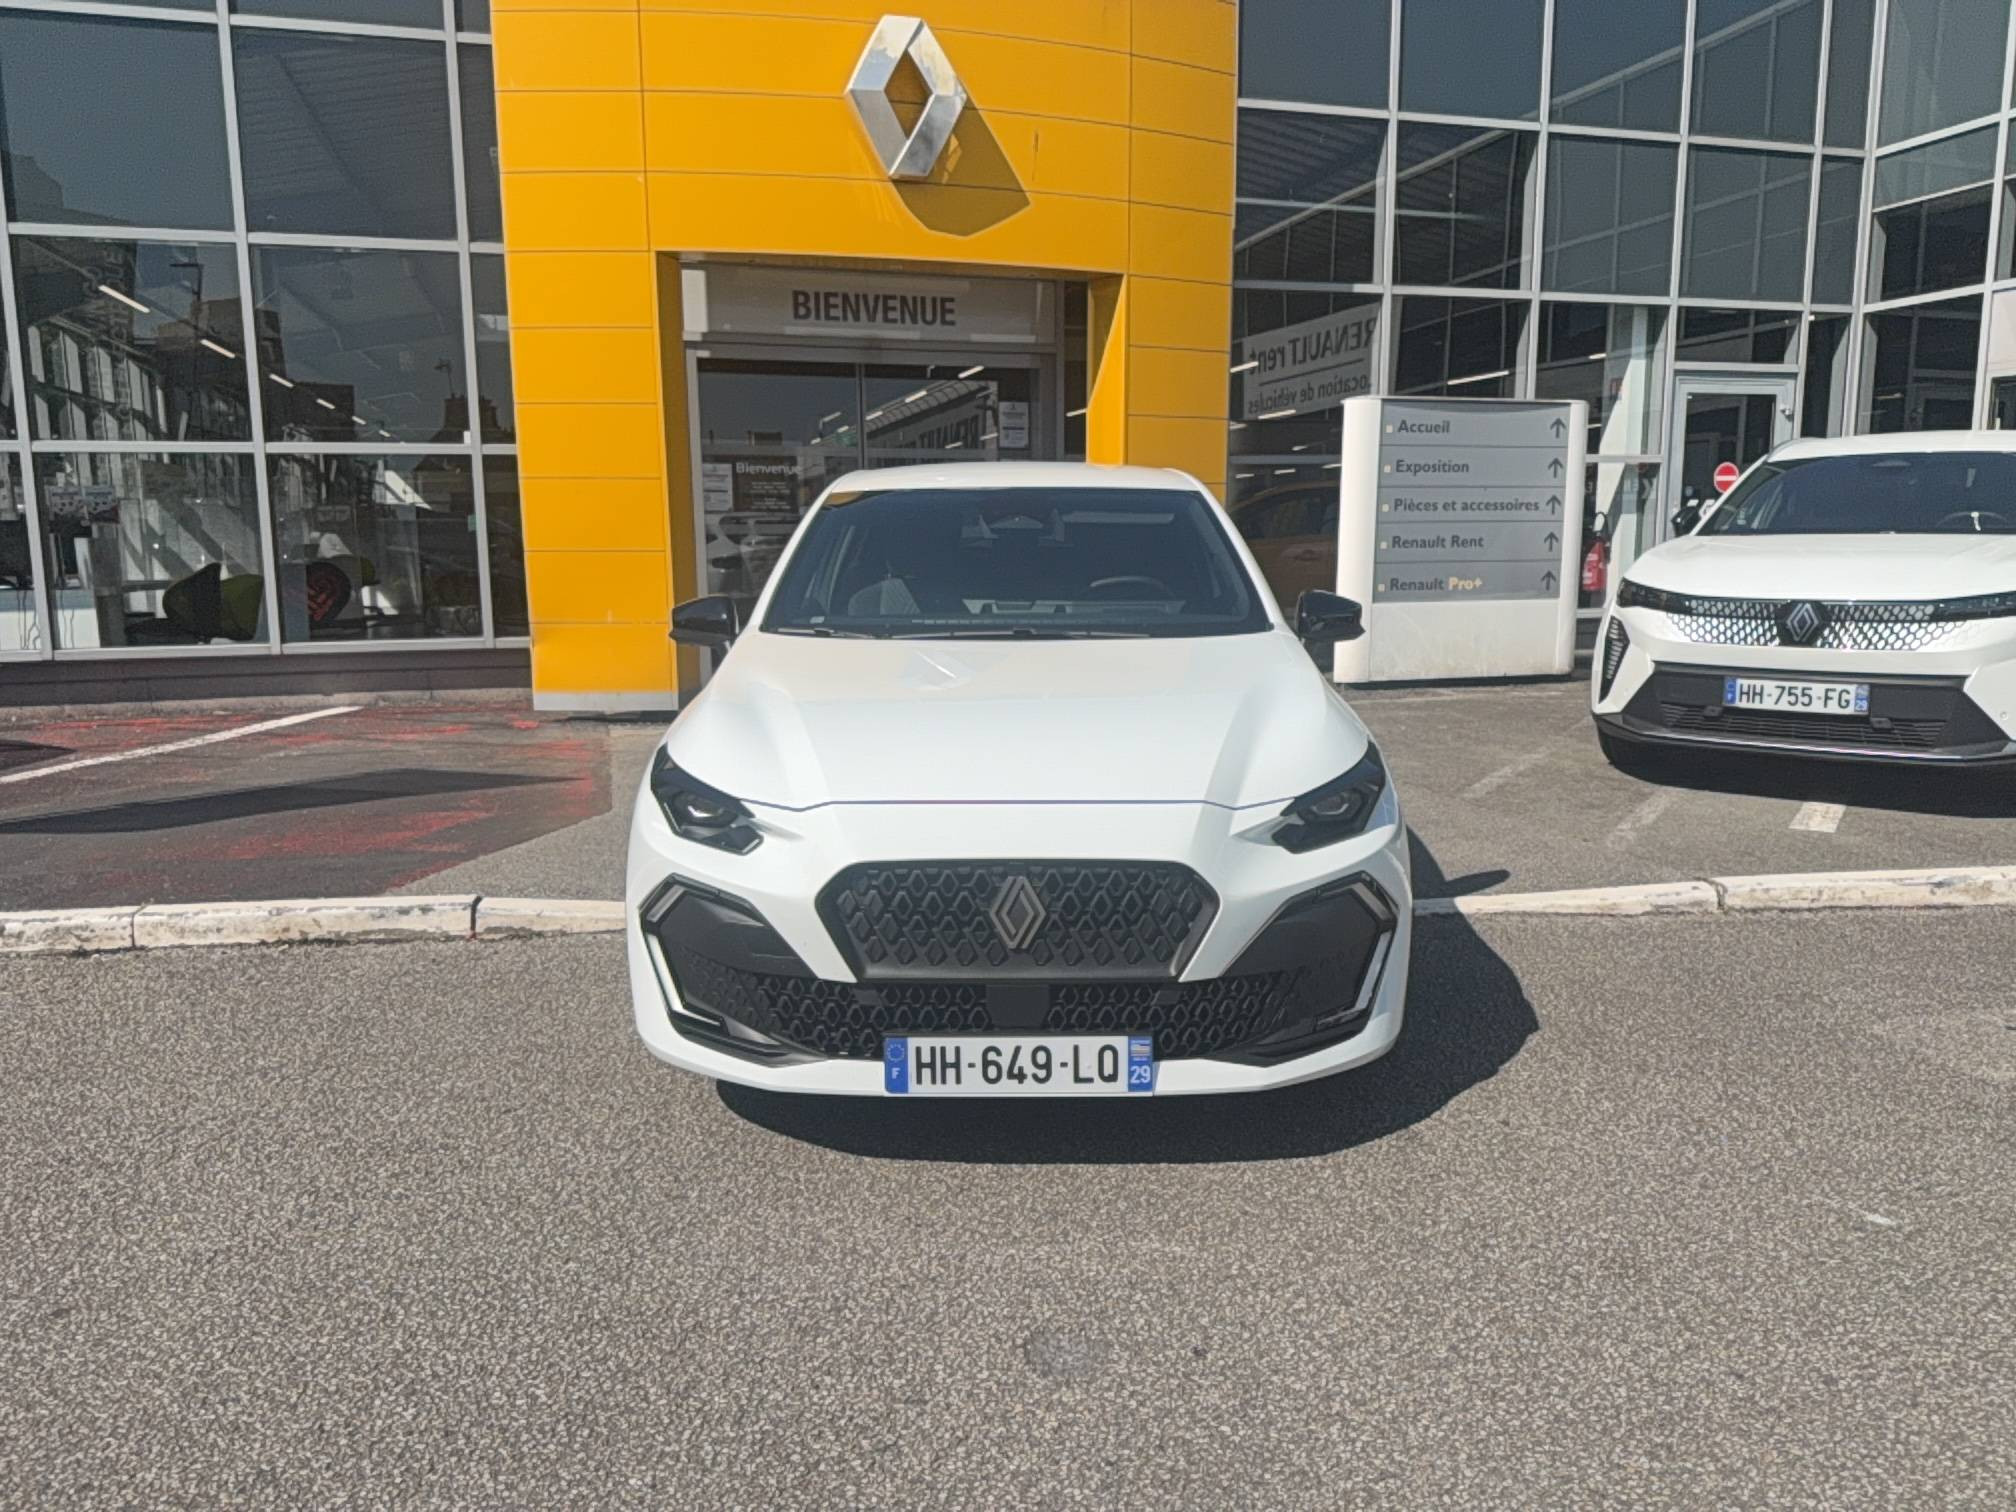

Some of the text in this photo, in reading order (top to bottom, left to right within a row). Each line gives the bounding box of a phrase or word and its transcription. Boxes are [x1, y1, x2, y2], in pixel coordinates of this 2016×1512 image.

[792, 290, 956, 326] BIENVENUE
[1397, 420, 1450, 433] Accueil
[736, 462, 803, 475] Bienvenue
[1396, 459, 1469, 476] Exposition
[1393, 498, 1540, 512] Pièces et accessoires
[1391, 535, 1484, 549] Renault Rent
[1390, 577, 1482, 591] Renault Pro+
[1738, 683, 1851, 709] HH-755-FG
[915, 1044, 1119, 1085] HH-649-LQ
[891, 1068, 900, 1079] F
[1130, 1065, 1151, 1084] 29
